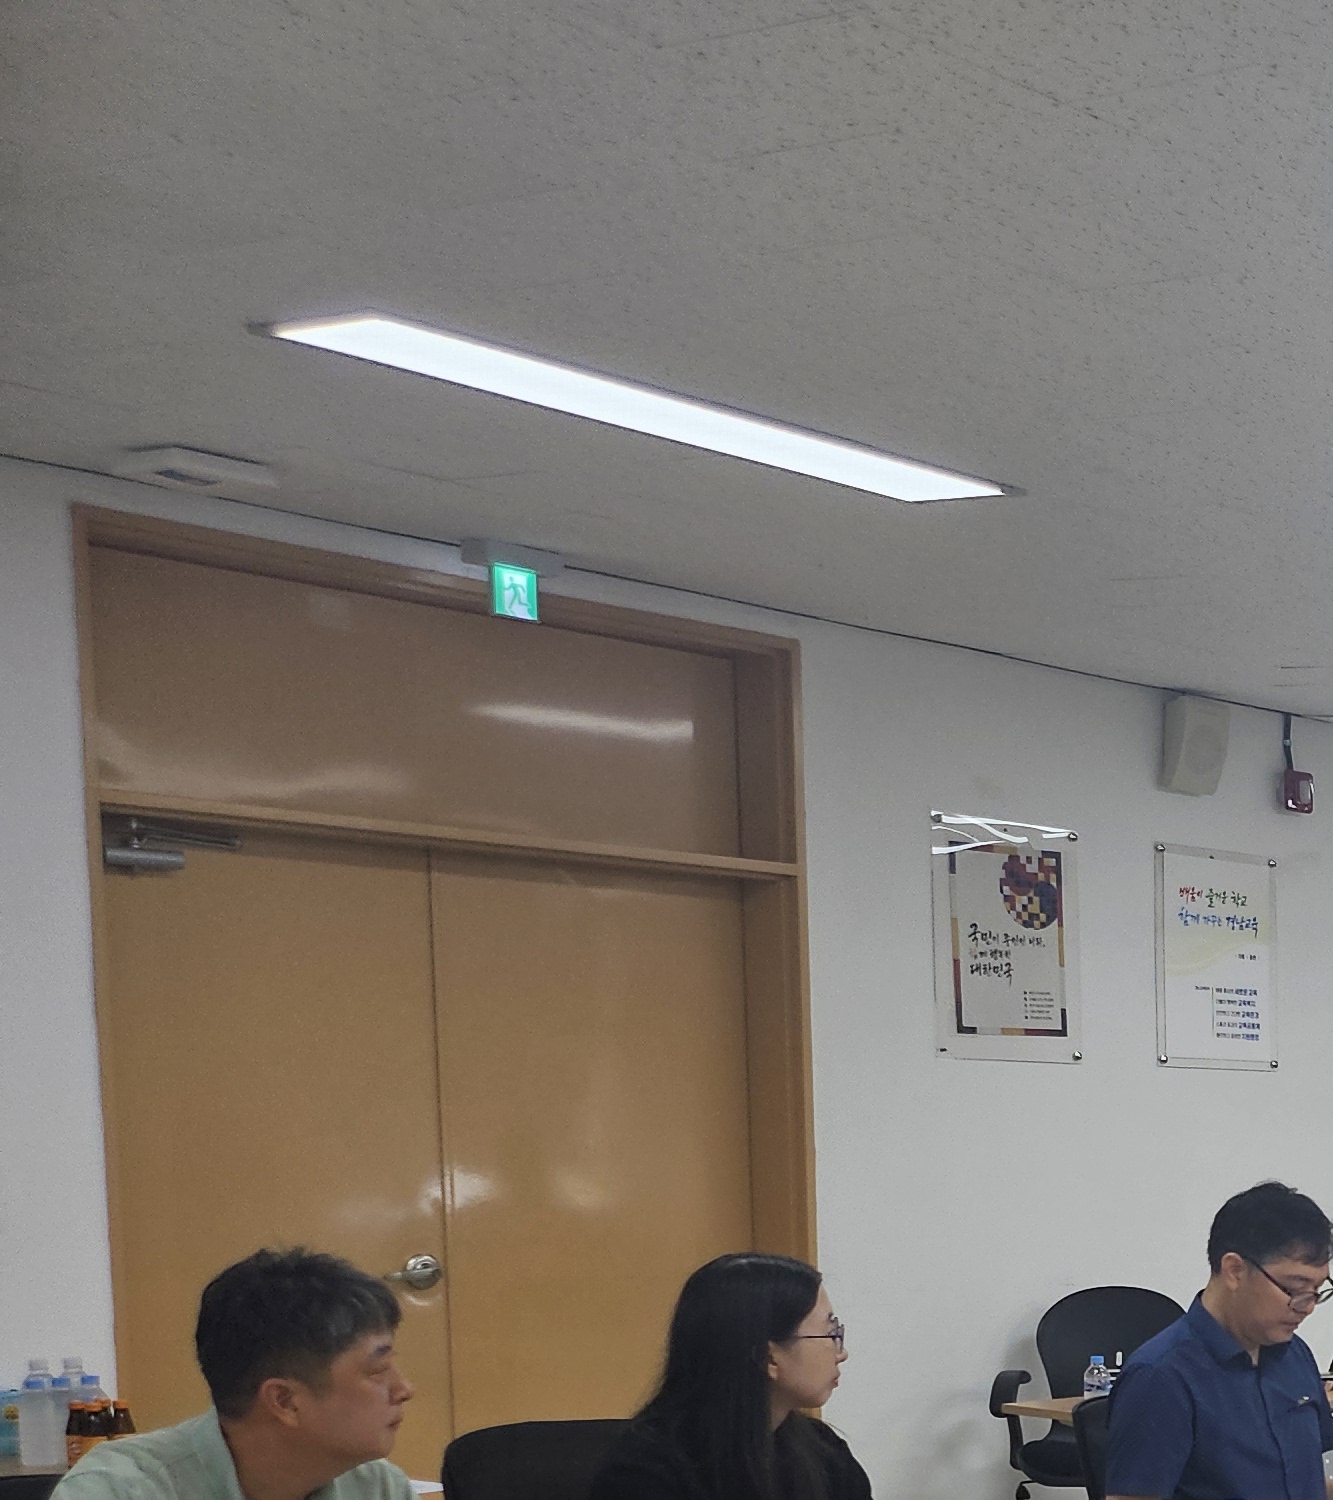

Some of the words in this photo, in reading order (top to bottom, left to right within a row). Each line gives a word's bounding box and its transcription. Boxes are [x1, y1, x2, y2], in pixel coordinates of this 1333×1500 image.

[1179, 887, 1203, 904] 배움이
[1230, 891, 1248, 908] 학교
[968, 923, 999, 948] 국민이
[1226, 915, 1258, 938] 경남교육
[969, 962, 1014, 987] 대한민국
